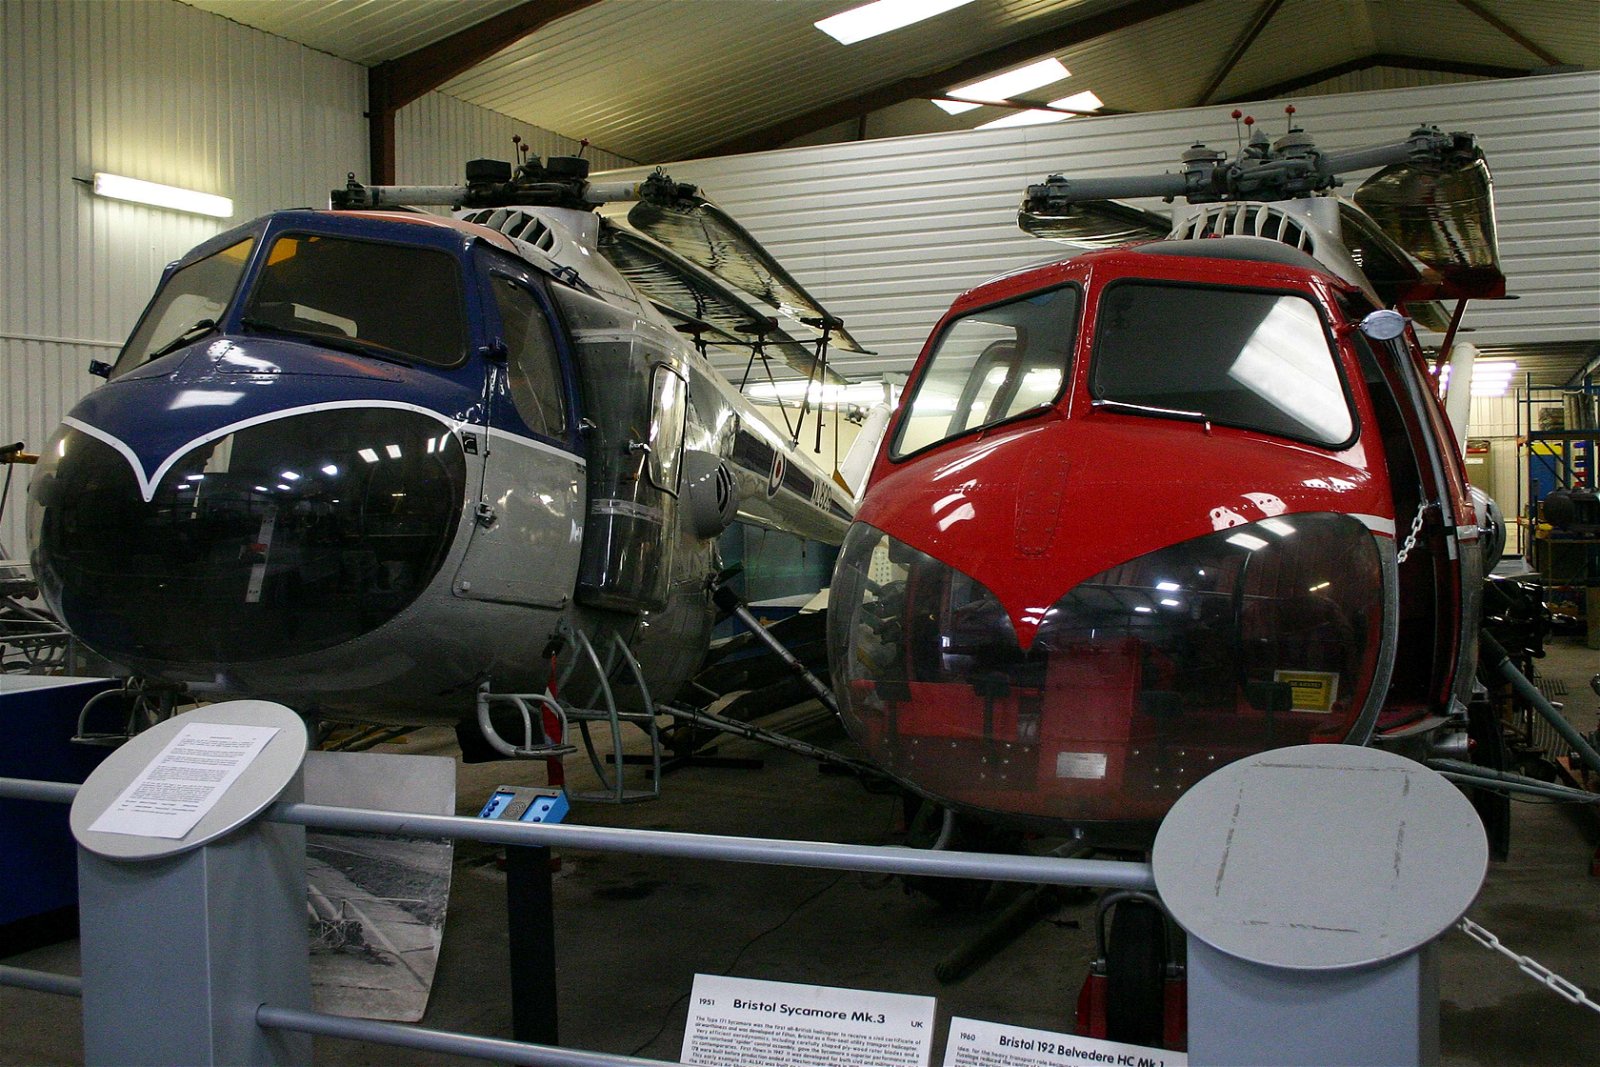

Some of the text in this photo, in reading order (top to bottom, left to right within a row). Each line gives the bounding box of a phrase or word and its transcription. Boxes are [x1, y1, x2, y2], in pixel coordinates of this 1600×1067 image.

[699, 997, 715, 1005] 1951
[734, 999, 885, 1024] Bristol Sycamore Mk.3
[910, 1020, 923, 1028] UK
[960, 1032, 975, 1041] 1960
[999, 1035, 1034, 1050] Bristol
[1037, 1041, 1054, 1053] 192
[1057, 1045, 1114, 1063] Belvedere
[1117, 1054, 1134, 1066] HC
